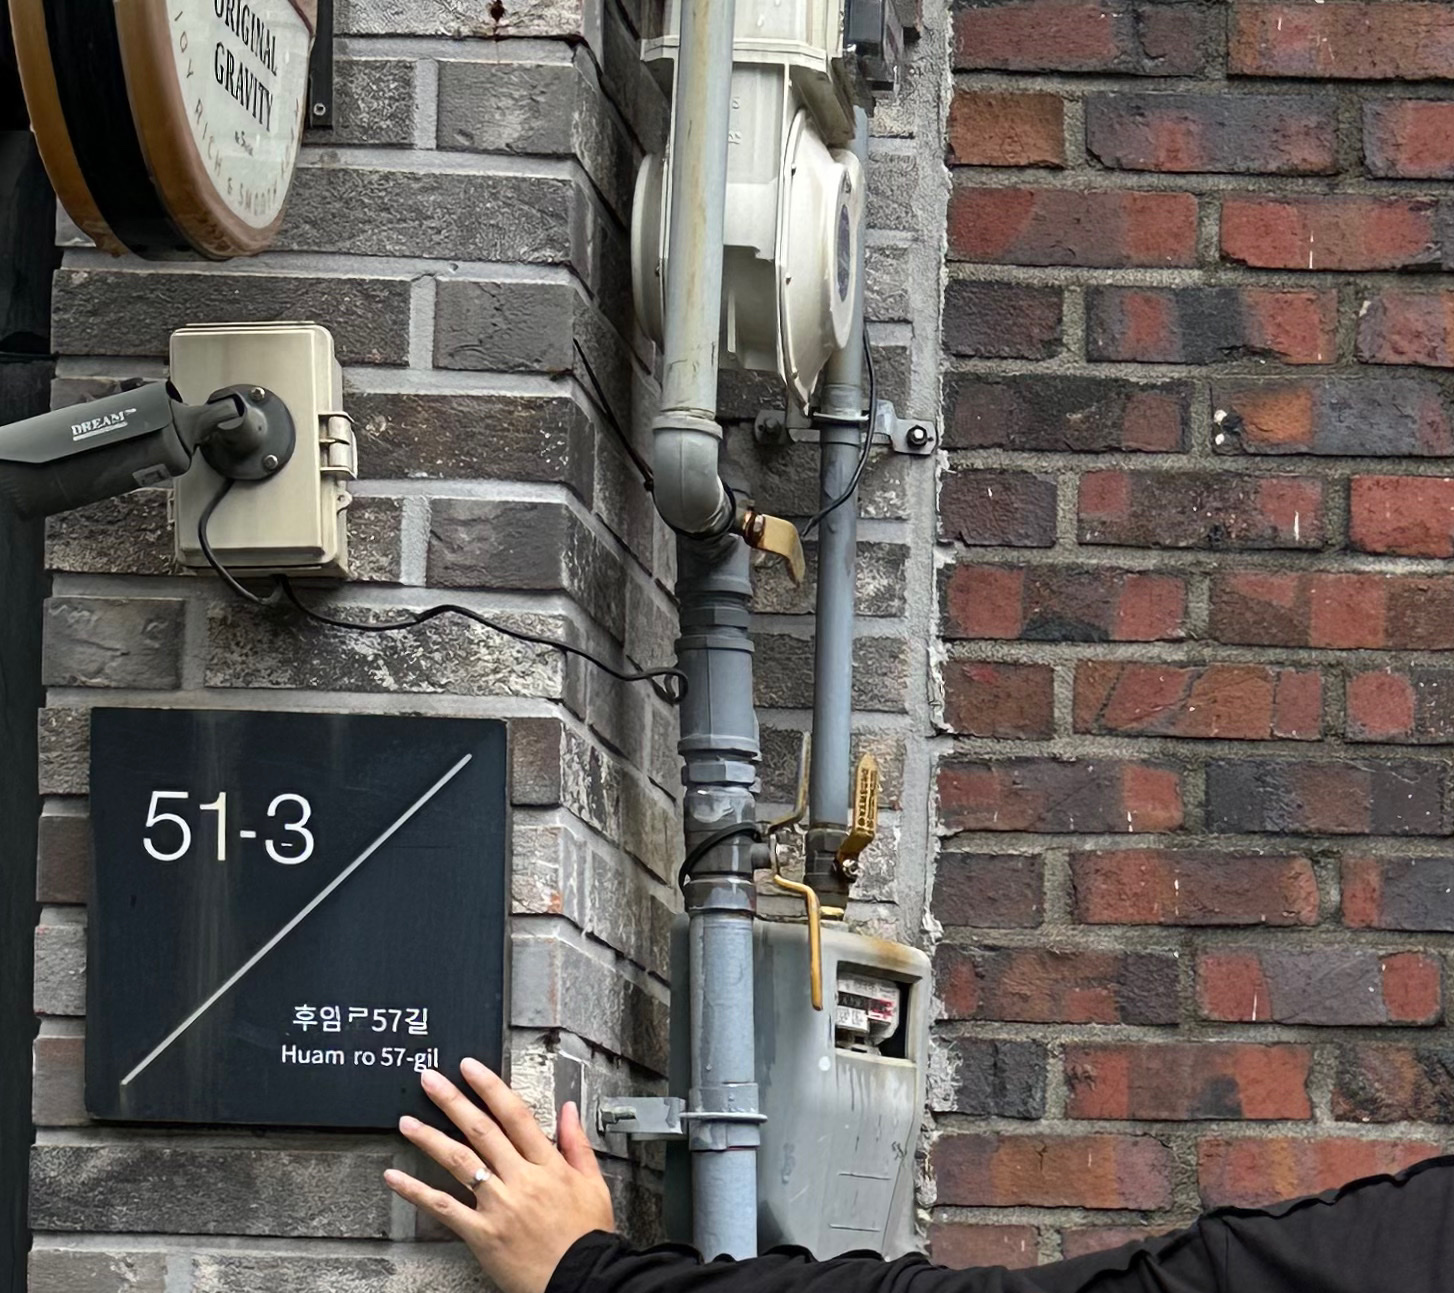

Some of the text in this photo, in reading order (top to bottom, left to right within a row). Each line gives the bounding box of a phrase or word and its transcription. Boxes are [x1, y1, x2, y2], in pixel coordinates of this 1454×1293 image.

[214, 42, 274, 132] GRAVITY
[143, 790, 315, 865] 51-3
[281, 1044, 439, 1073] Huam ro 57-gil
